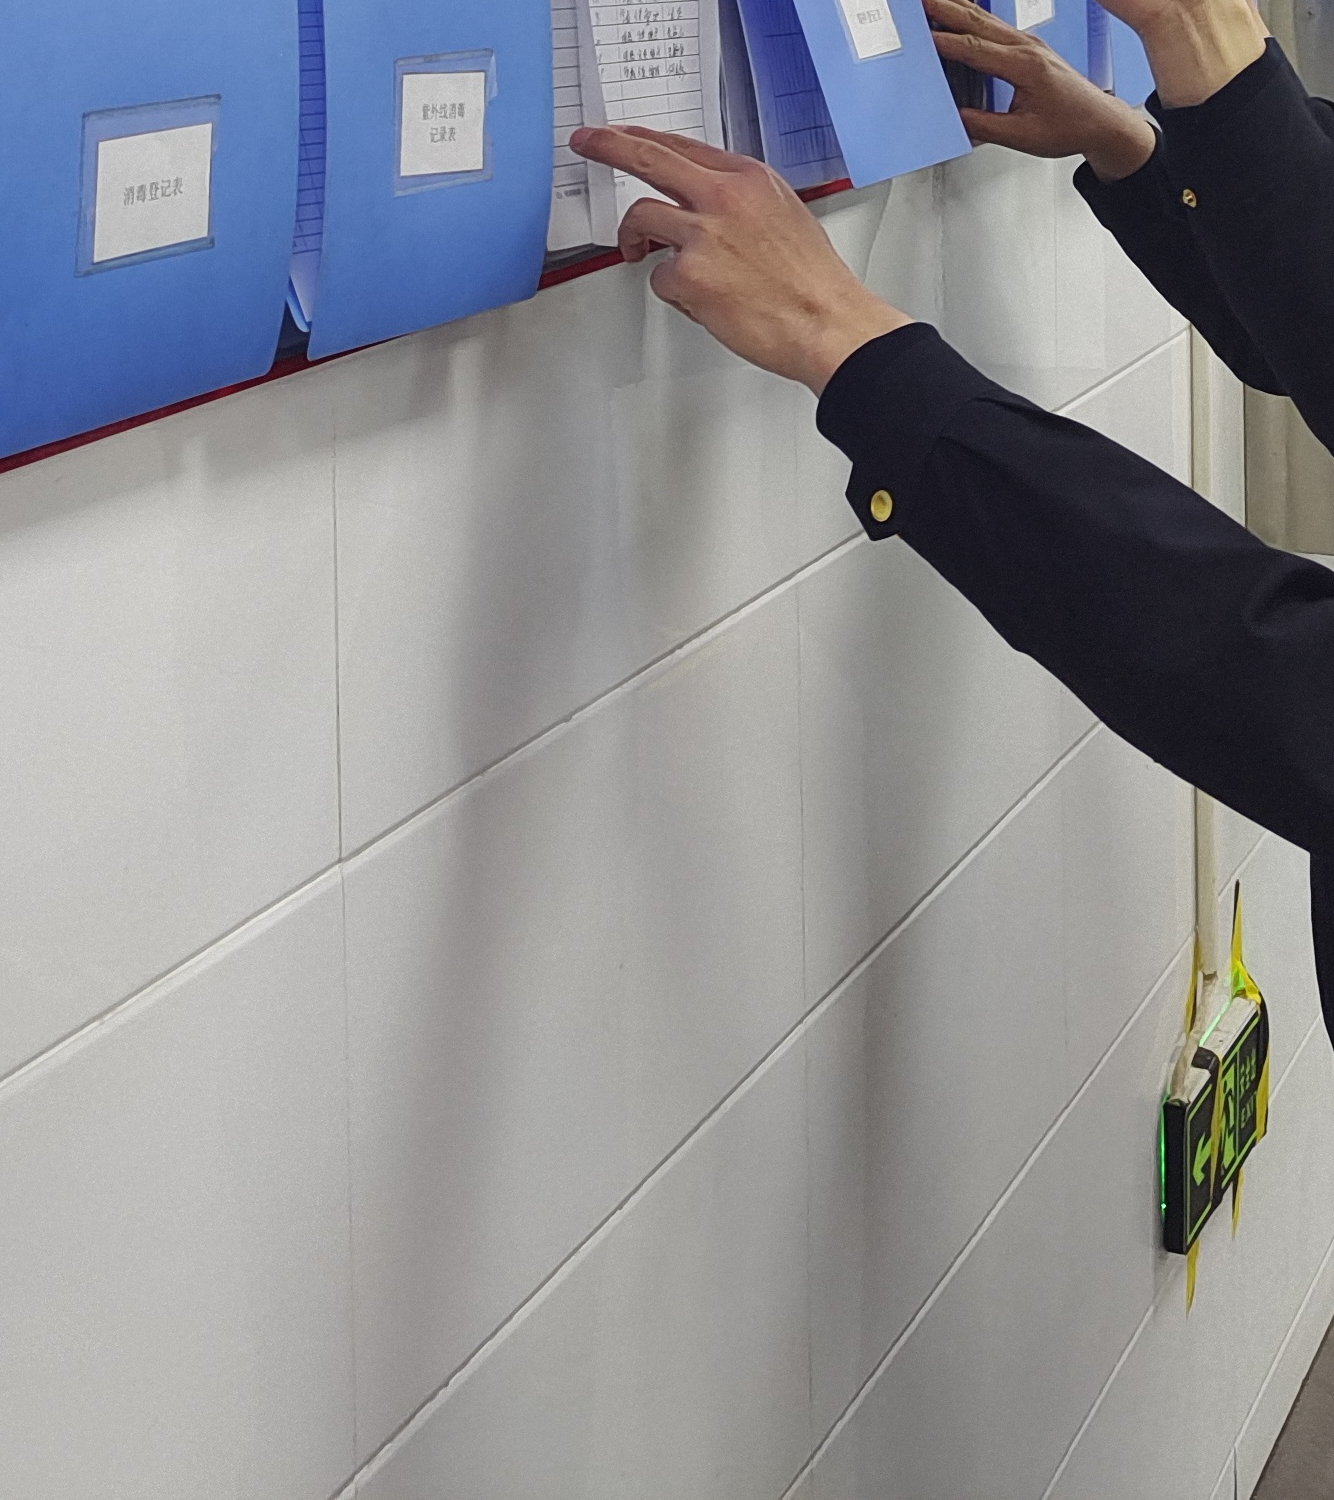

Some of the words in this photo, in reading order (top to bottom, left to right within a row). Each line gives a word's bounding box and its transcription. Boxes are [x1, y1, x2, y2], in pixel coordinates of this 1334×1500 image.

[429, 125, 457, 143] 记录表
[123, 176, 183, 206] 消毒登记表
